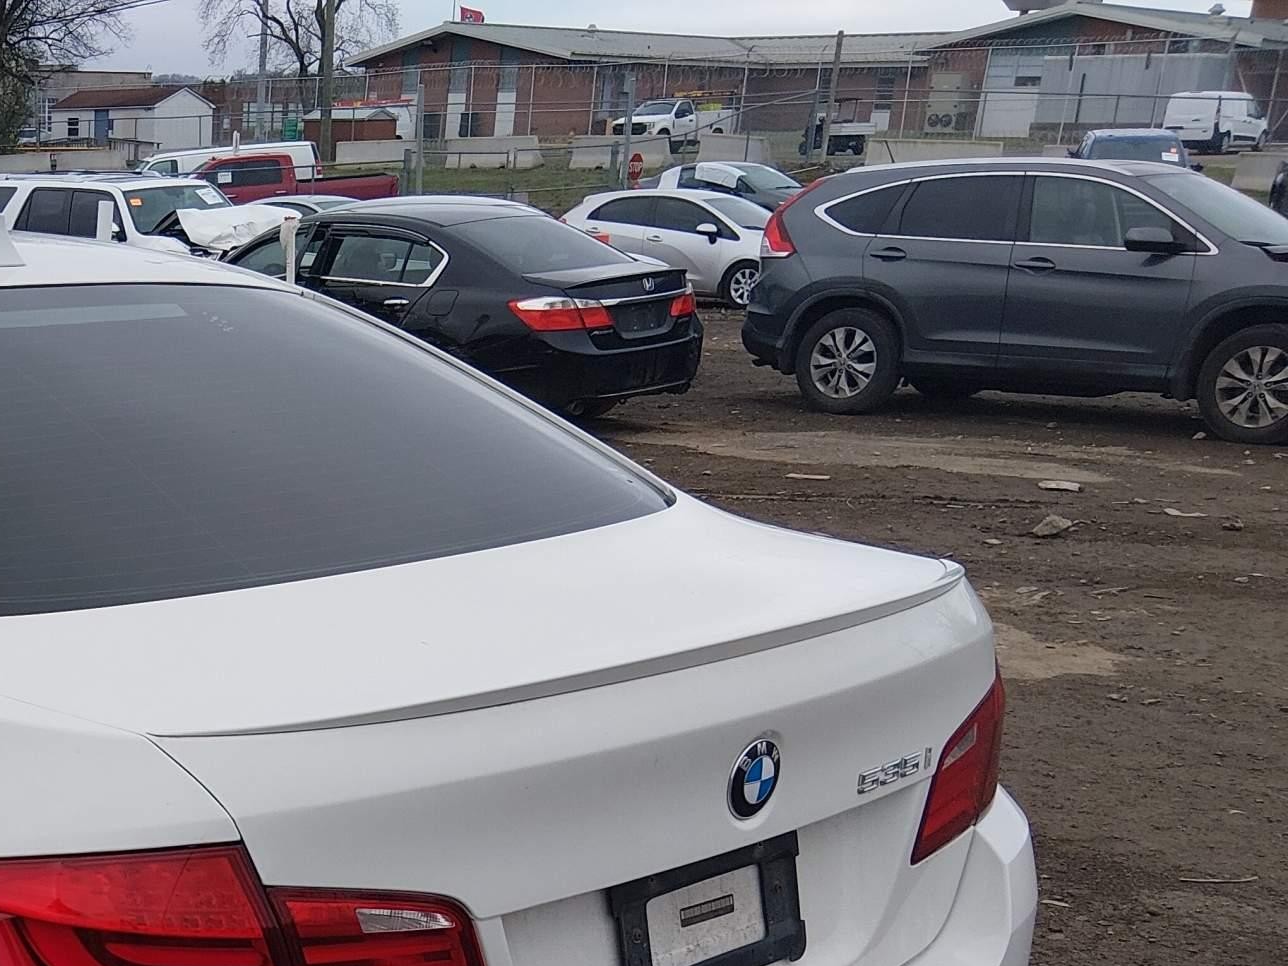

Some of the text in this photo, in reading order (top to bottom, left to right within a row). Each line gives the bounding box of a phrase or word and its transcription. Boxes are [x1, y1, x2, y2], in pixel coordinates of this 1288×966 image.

[629, 161, 643, 173] STOP
[739, 741, 779, 772] BMW
[857, 747, 932, 795] 535i
